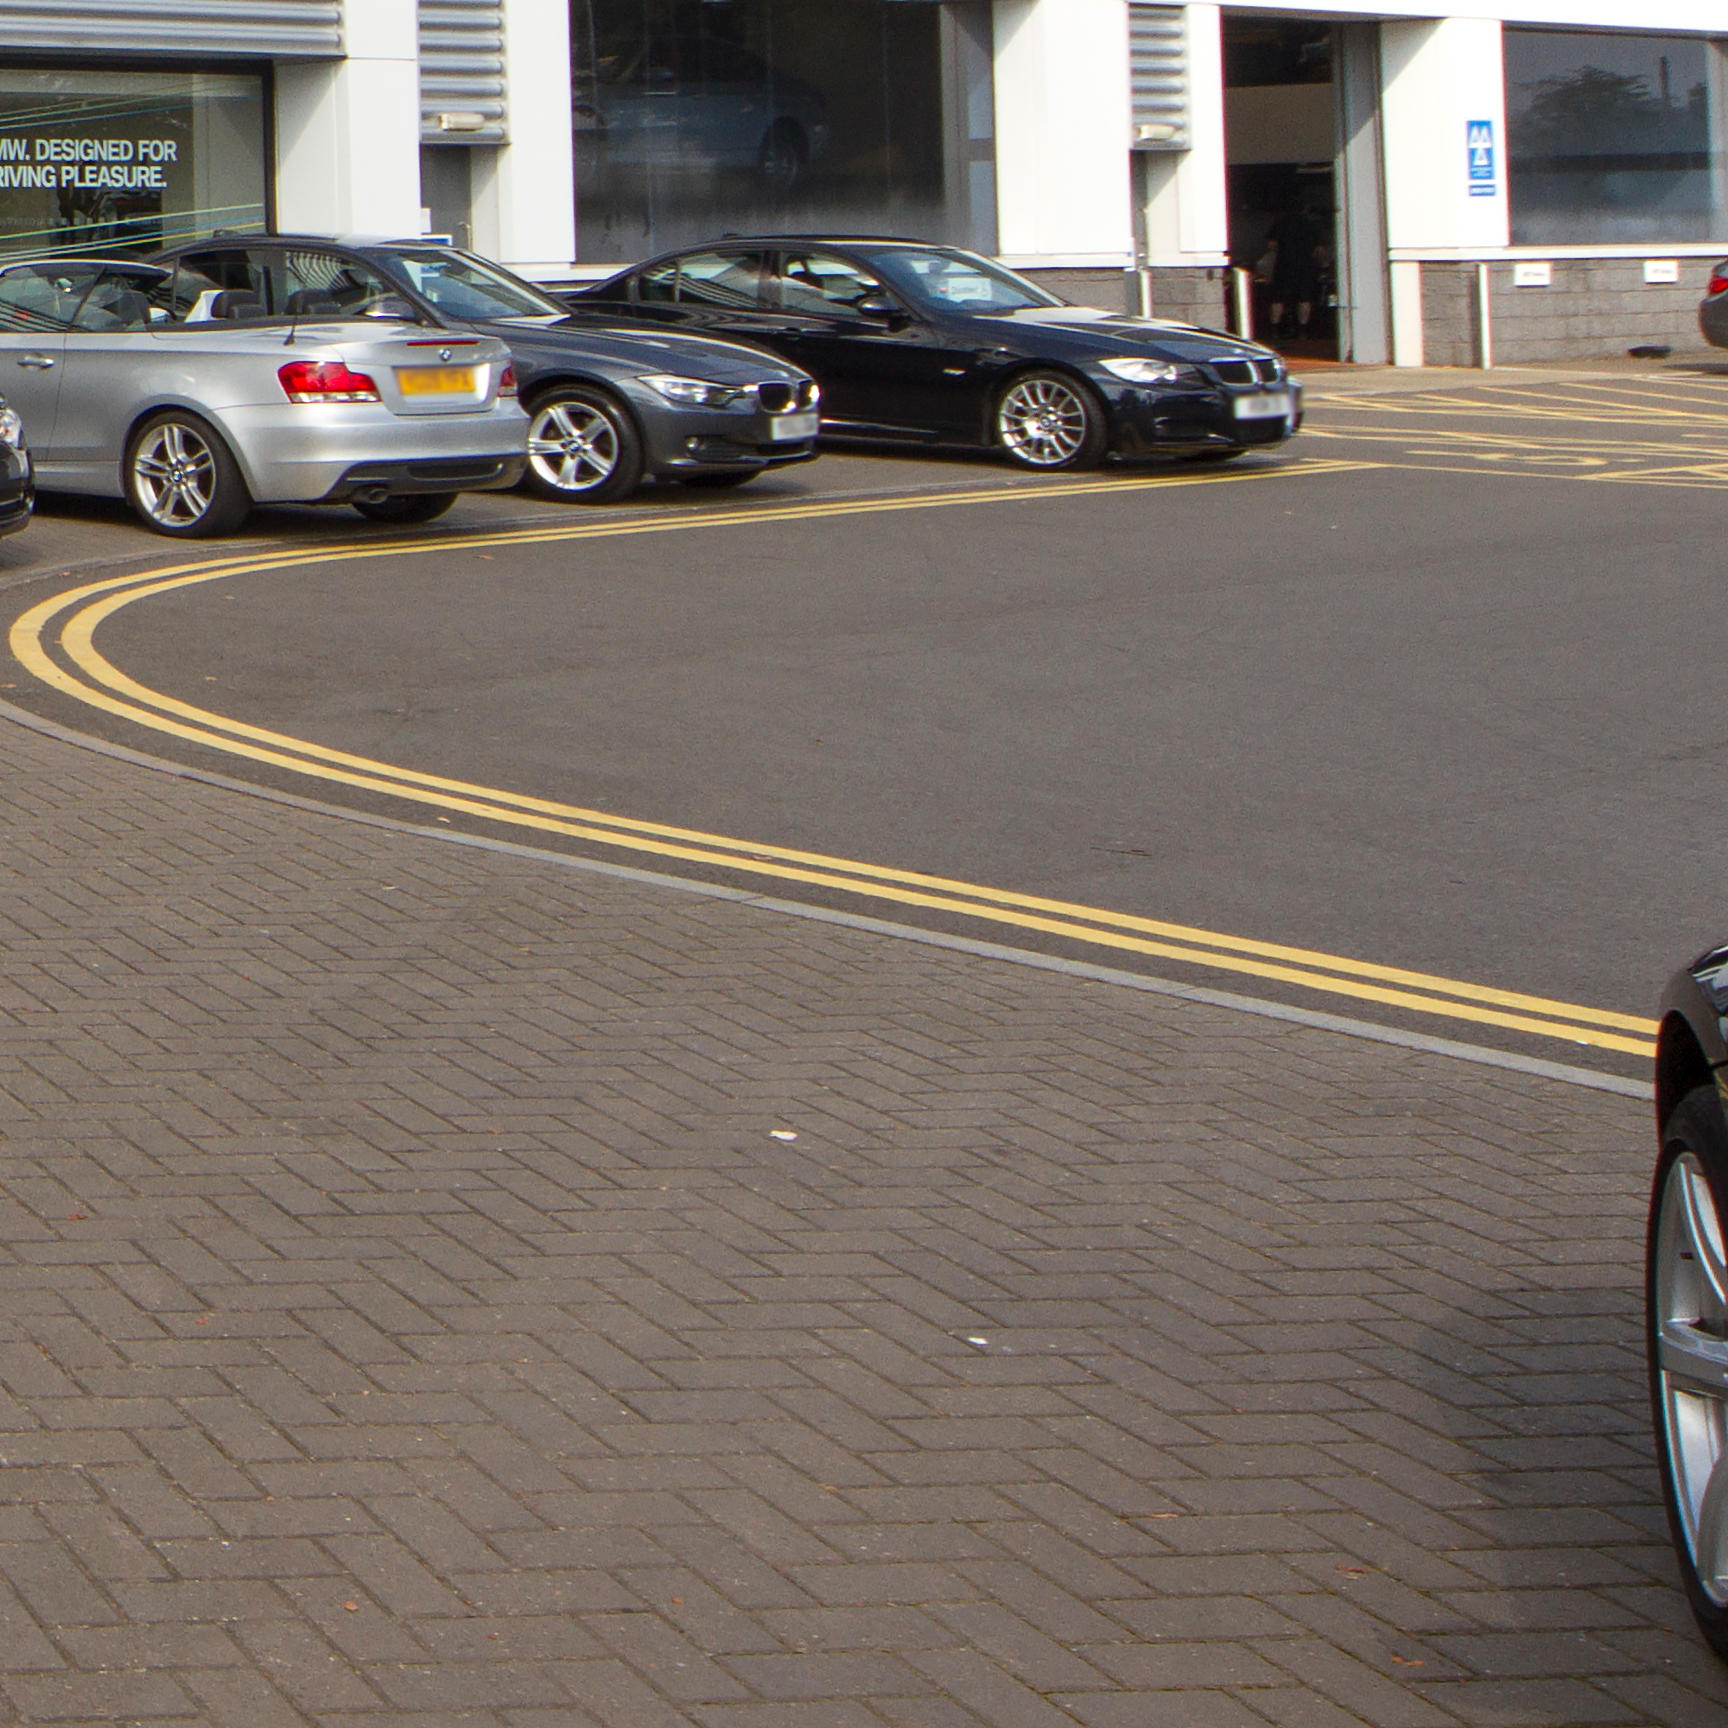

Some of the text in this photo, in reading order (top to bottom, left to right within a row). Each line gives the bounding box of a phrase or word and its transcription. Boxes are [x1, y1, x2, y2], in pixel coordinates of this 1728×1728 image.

[36, 139, 133, 162] DESIGNED
[138, 140, 177, 162] FOR
[62, 165, 167, 188] PLEASURE.
